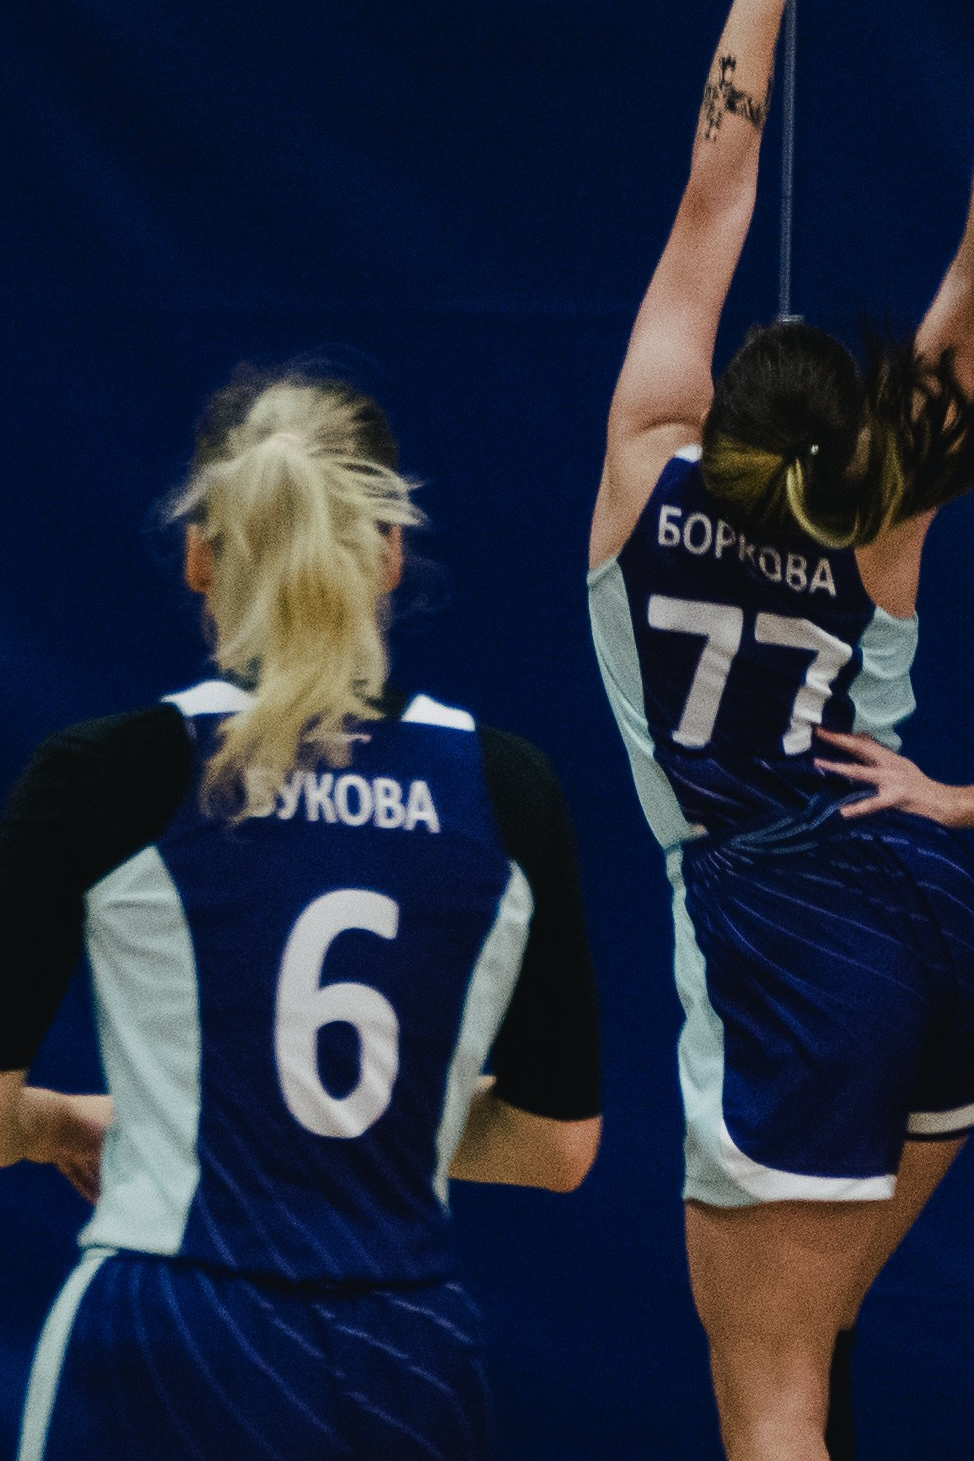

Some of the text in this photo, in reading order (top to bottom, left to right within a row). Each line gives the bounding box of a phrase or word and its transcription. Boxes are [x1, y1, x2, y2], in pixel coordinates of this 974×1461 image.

[647, 593, 853, 756] 77
[248, 768, 441, 834] УКОВА
[274, 888, 400, 1139] 6
